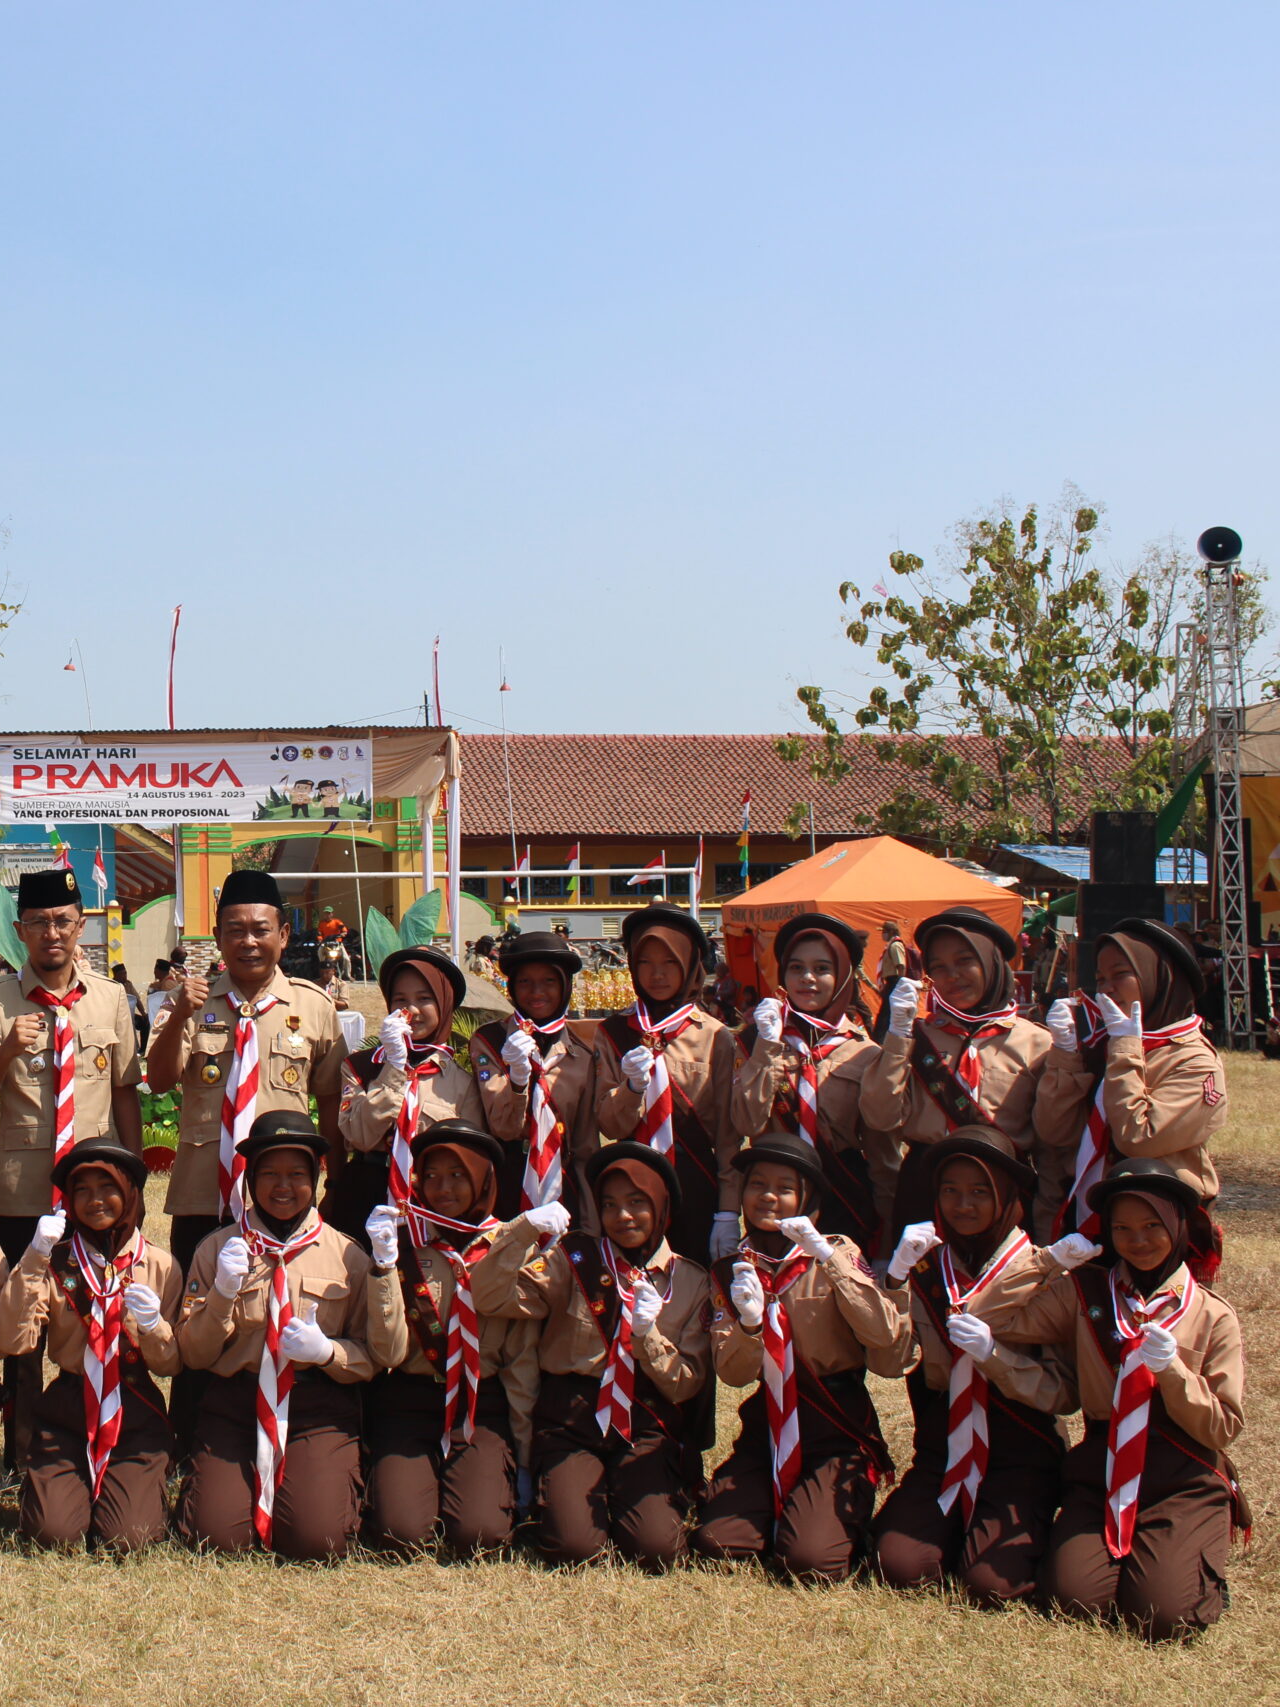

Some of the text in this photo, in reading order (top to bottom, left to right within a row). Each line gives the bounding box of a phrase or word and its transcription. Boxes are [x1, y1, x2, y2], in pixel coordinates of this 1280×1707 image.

[13, 747, 137, 760] SELAMAT HARI
[12, 758, 244, 790] PRAMUKA
[127, 791, 140, 799] 14
[141, 791, 186, 799] AGUSTUS
[221, 790, 246, 798] 2023
[13, 800, 130, 809] SUMBER DAYA MANUSIA
[13, 808, 230, 818] YANG PROFESIONAL DAN PROPOSIONAL
[730, 907, 747, 921] SMK
